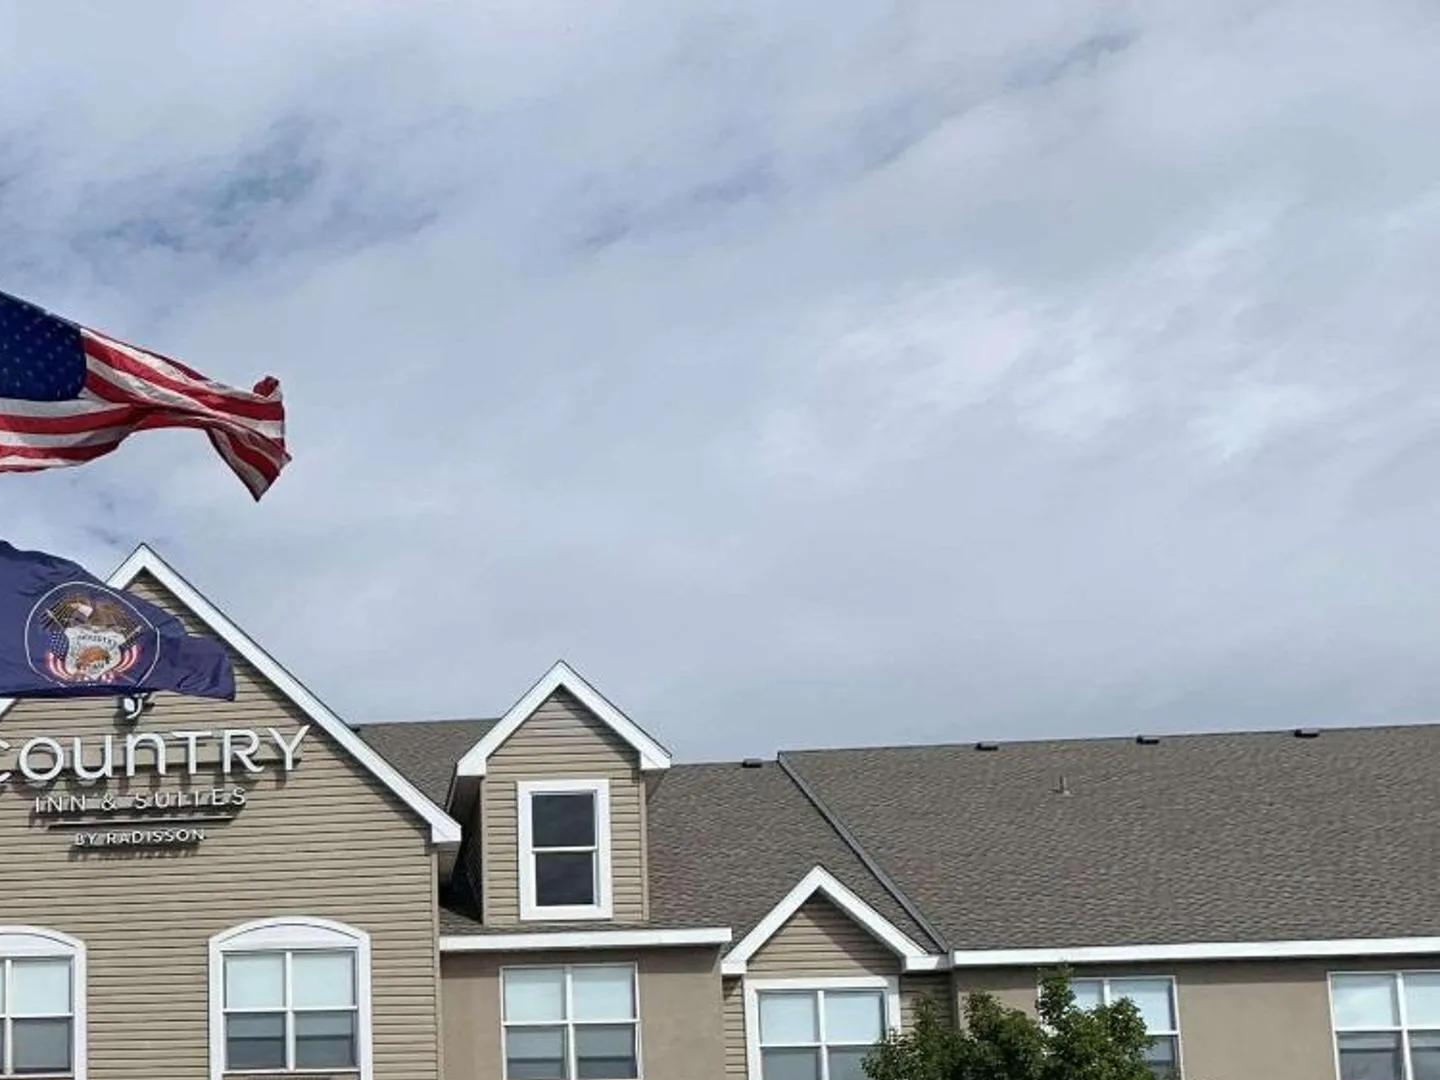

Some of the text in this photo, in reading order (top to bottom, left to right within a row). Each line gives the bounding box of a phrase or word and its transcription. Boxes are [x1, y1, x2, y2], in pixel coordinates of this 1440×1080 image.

[35, 788, 246, 813] INN & SUITES
[75, 828, 205, 846] BY RADISSON
